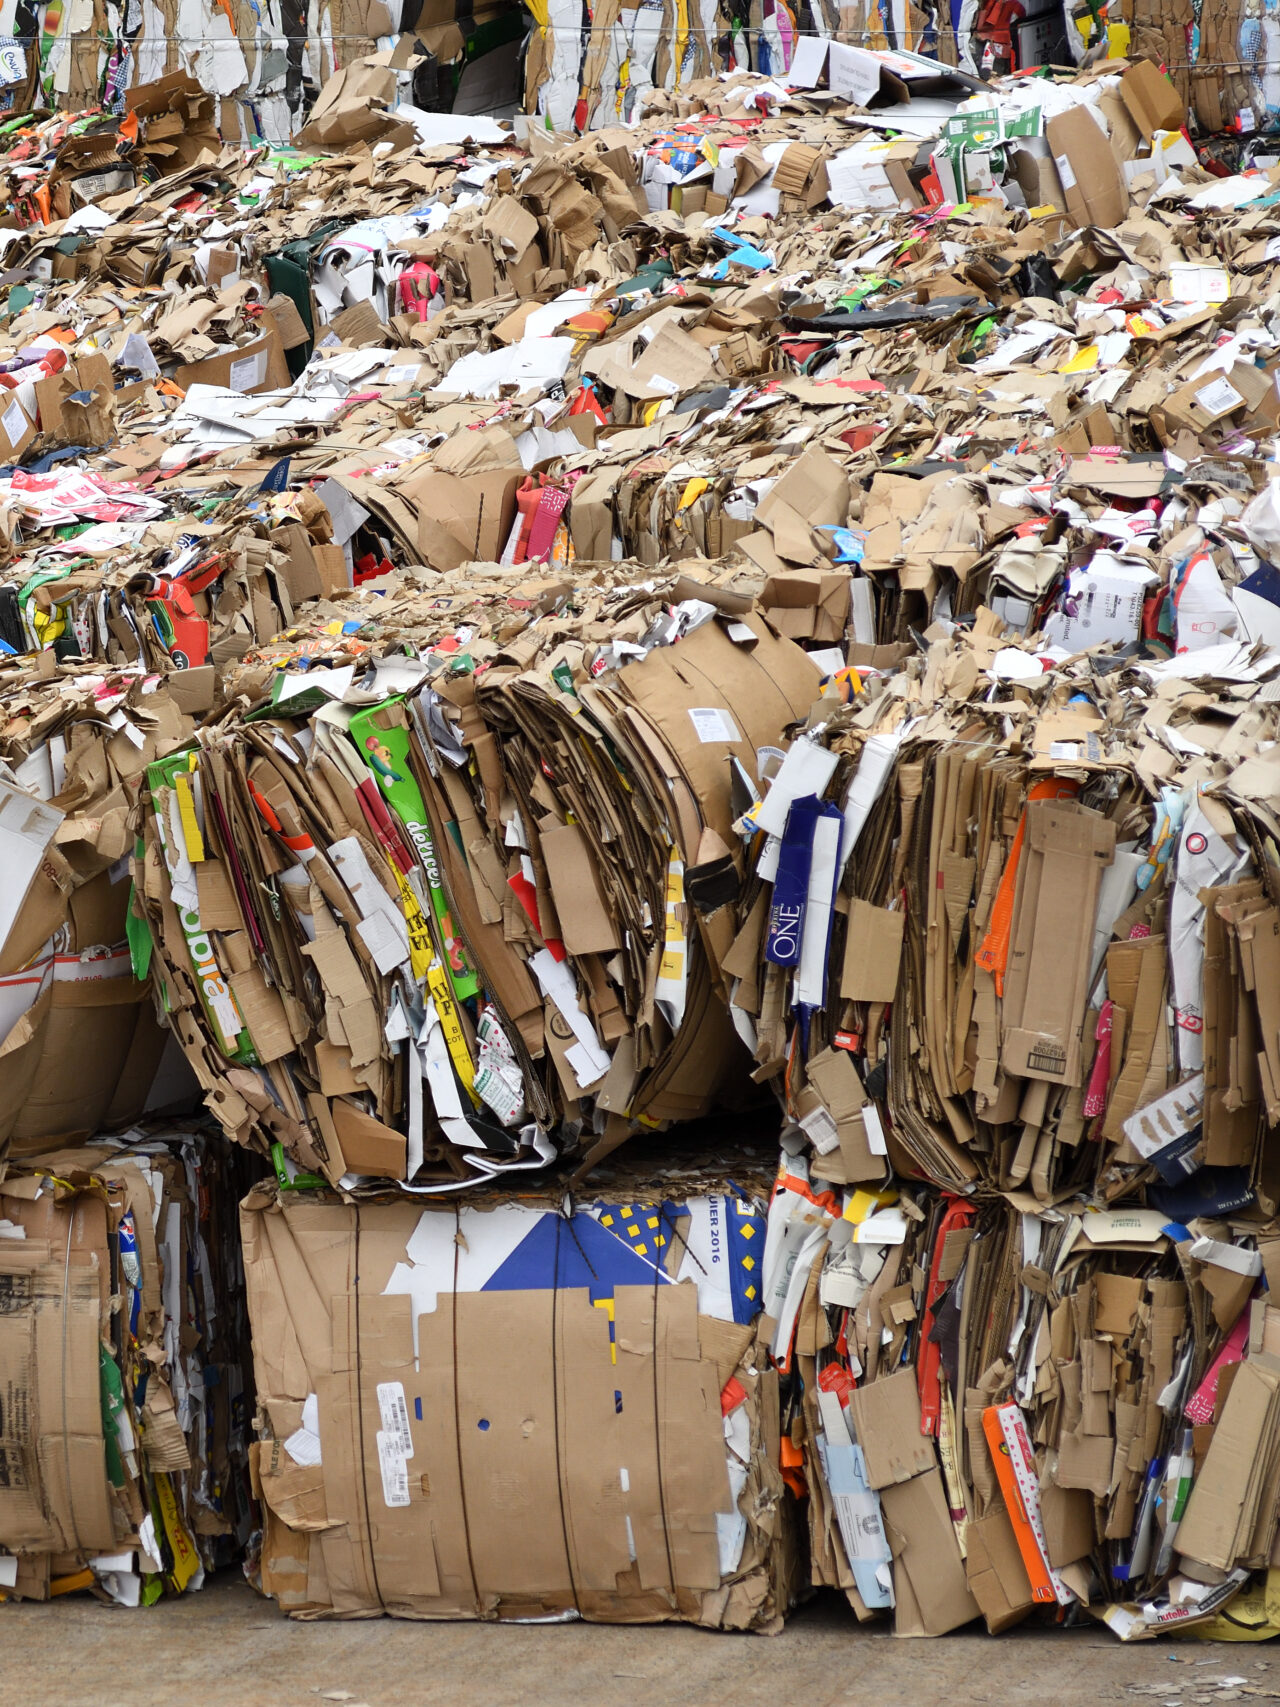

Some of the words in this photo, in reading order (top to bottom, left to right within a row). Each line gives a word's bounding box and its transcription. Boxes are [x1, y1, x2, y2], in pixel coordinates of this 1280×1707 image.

[406, 821, 441, 889] délices
[773, 905, 800, 959] ONE
[704, 1194, 718, 1226] UIER
[711, 1229, 721, 1264] 2016
[1157, 1608, 1189, 1622] nutella
